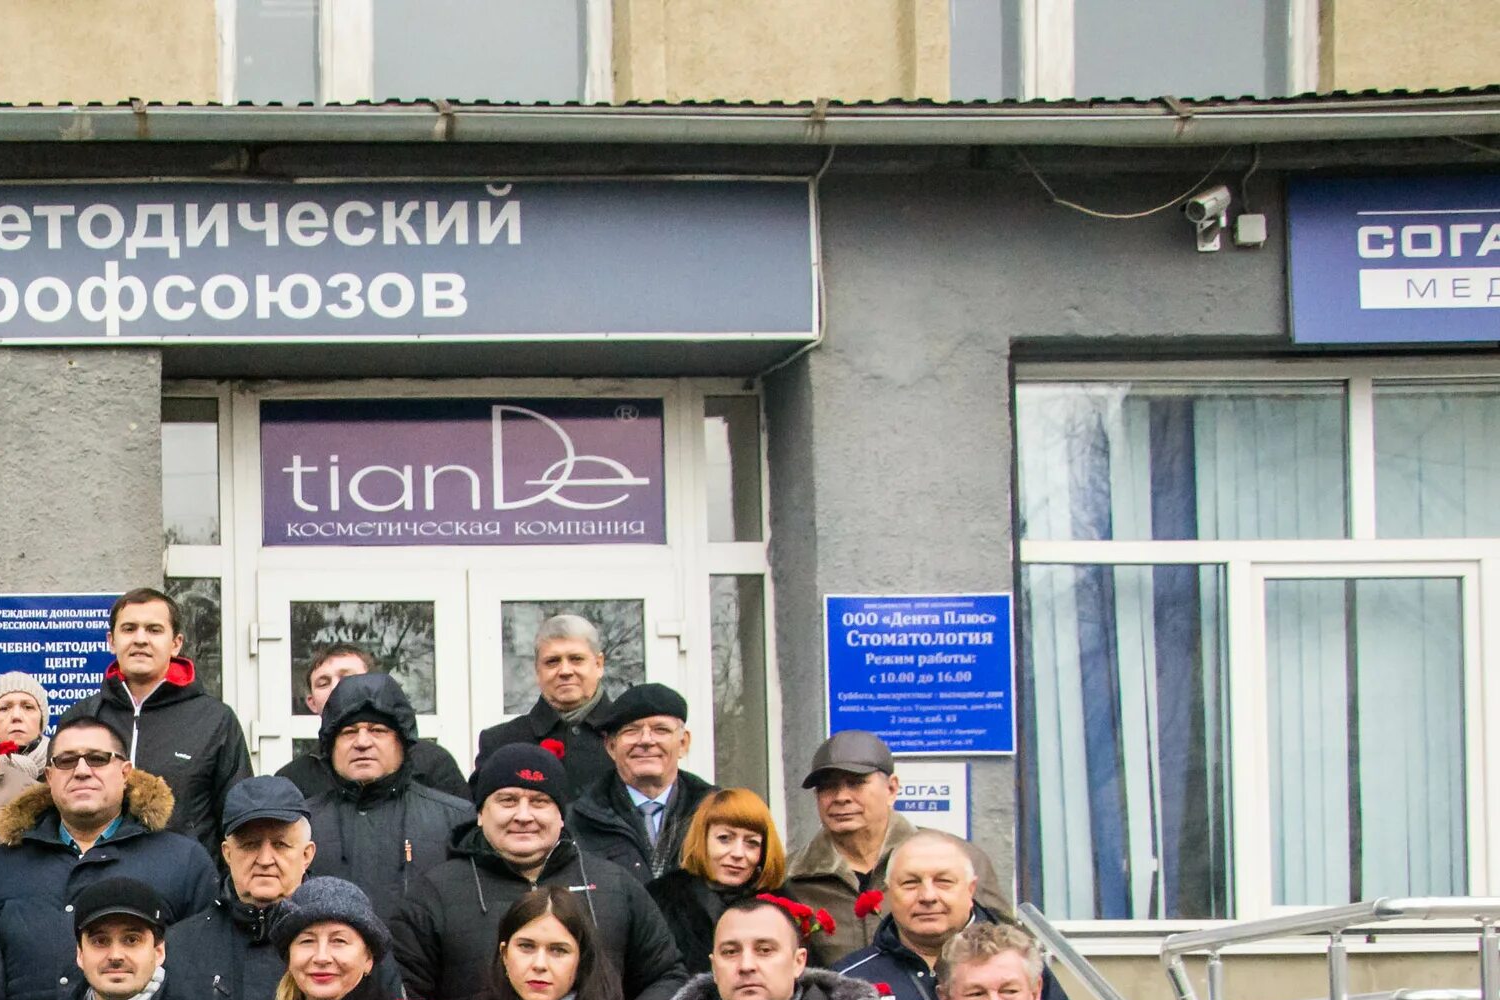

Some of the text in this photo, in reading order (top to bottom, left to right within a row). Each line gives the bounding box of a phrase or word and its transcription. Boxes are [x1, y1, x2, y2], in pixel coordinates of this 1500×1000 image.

[515, 519, 646, 537] компания
[85, 620, 110, 629] ОБРА
[842, 610, 997, 627] ООО «Дента Плюс»
[846, 629, 994, 647] Стоматология
[45, 657, 88, 670] ЦЕНТР
[865, 651, 977, 667] Режим работы:
[59, 673, 104, 684] ОРГАН
[905, 801, 938, 812] МЕД
